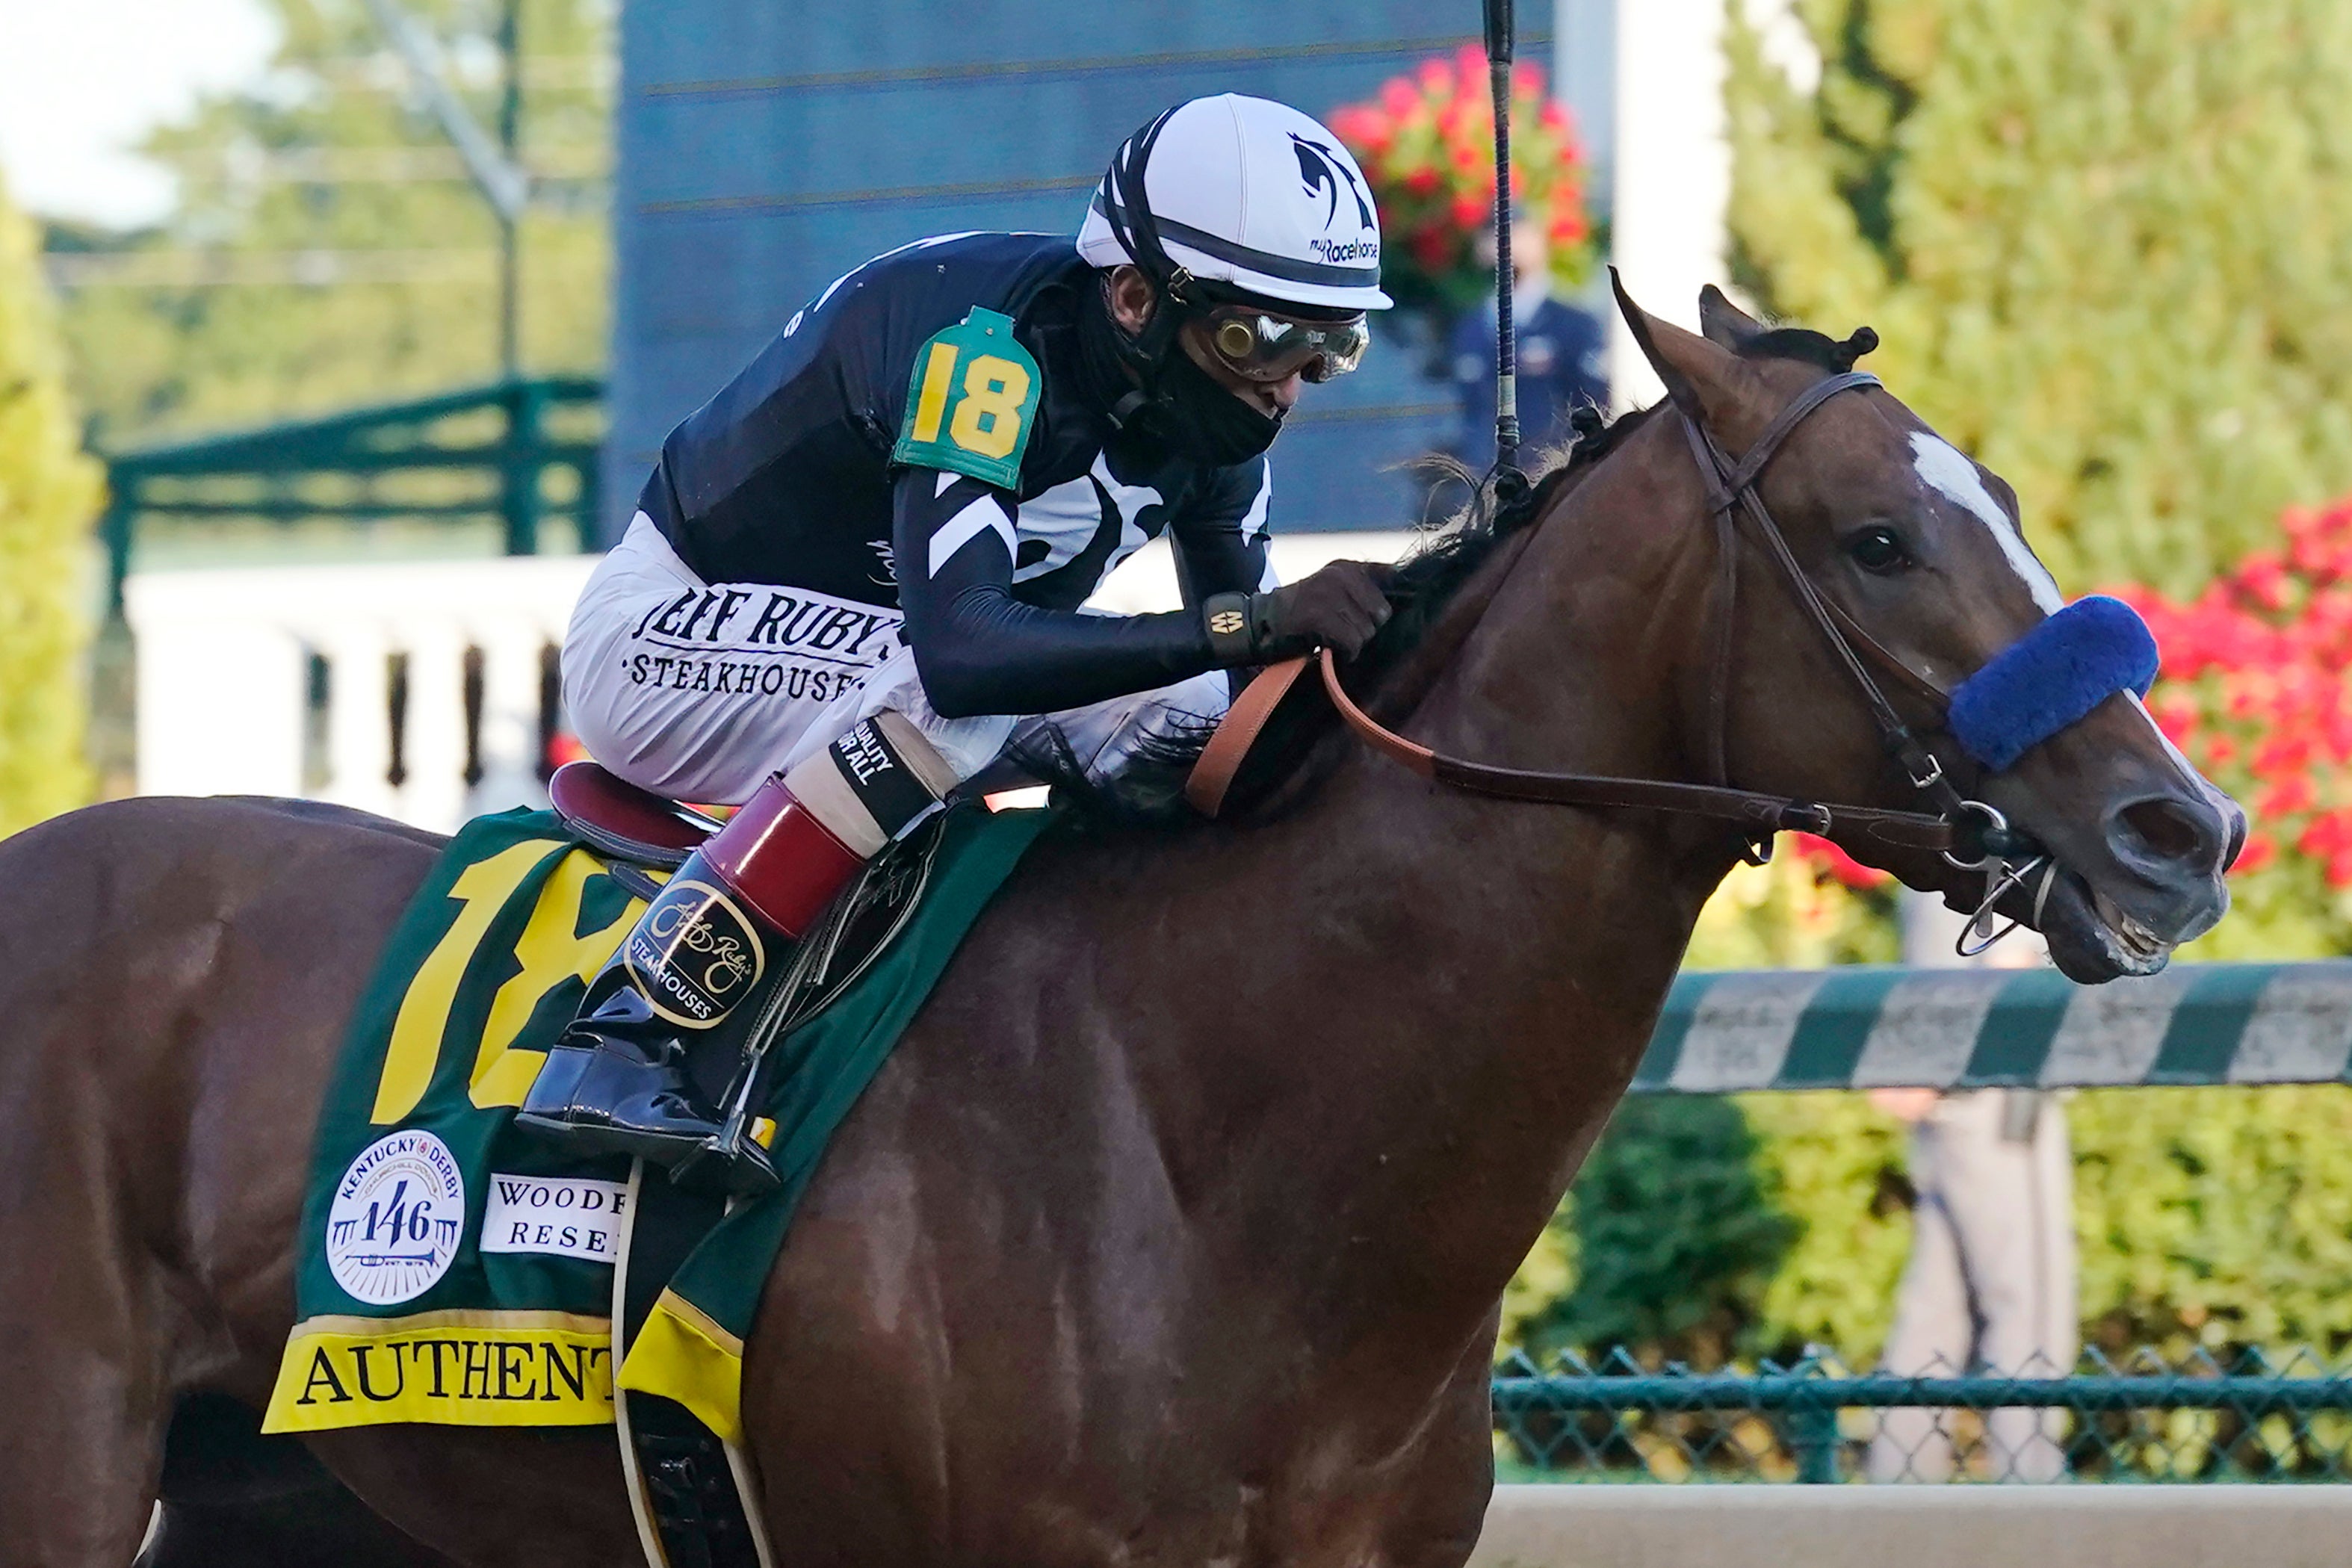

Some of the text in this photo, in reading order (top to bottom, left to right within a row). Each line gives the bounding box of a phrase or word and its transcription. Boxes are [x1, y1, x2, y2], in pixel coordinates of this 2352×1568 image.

[912, 342, 1030, 459] 18
[845, 750, 876, 786] ALL
[370, 837, 673, 1125] 18
[631, 938, 712, 1020] STEAKHOUSES
[341, 1138, 459, 1200] KENTUCKY DERBY
[360, 1180, 431, 1250] 146
[508, 1221, 619, 1255] RESE
